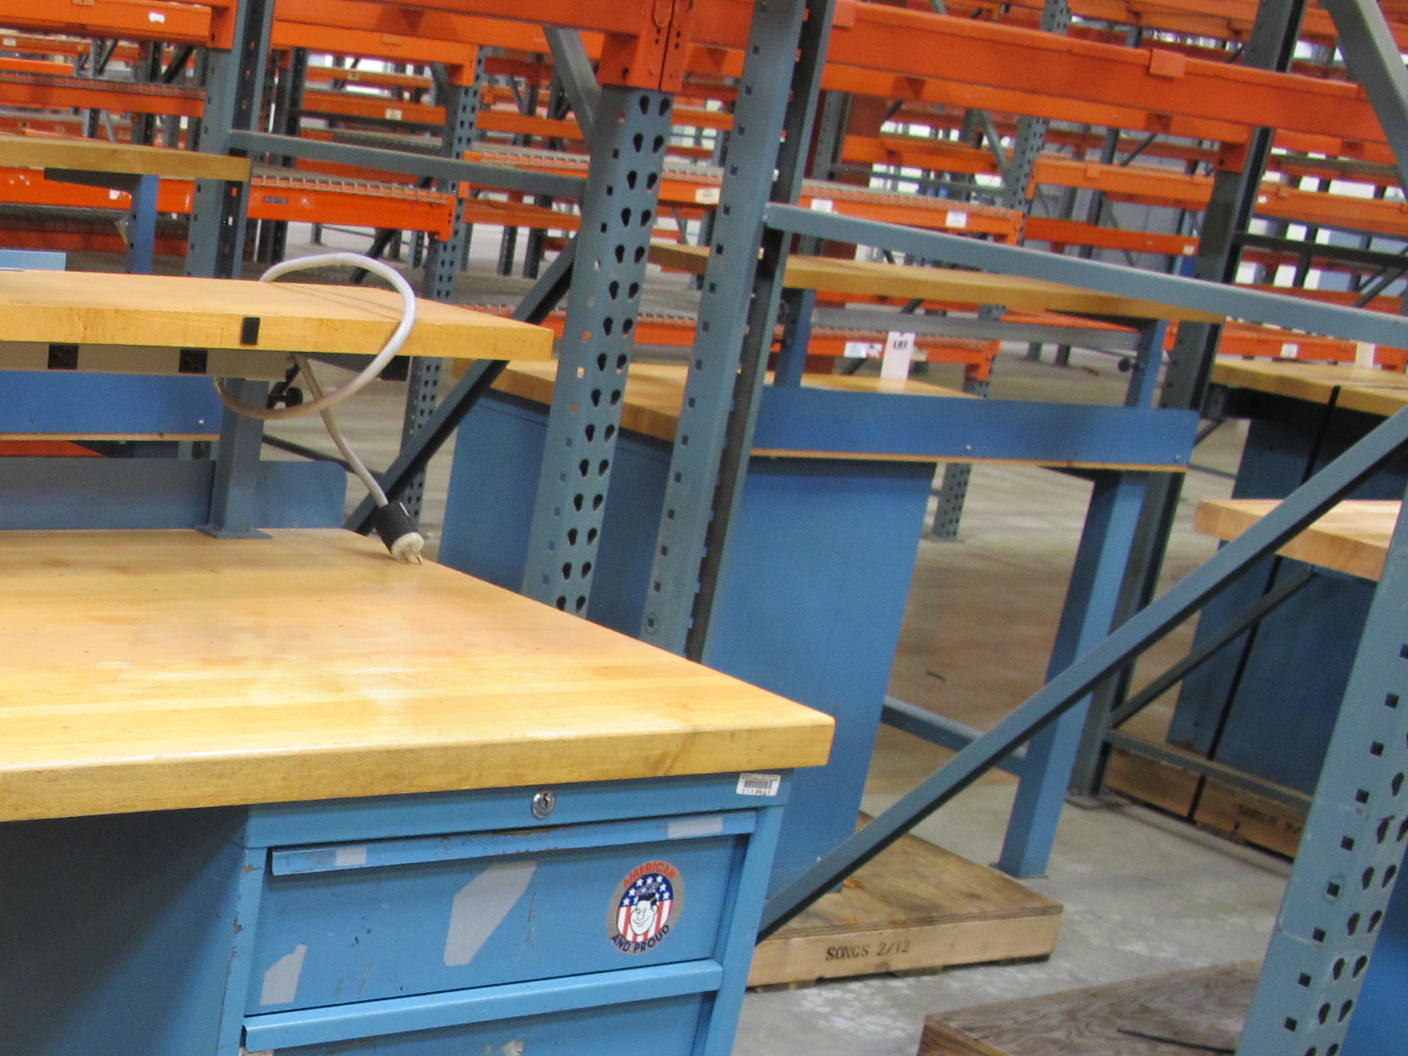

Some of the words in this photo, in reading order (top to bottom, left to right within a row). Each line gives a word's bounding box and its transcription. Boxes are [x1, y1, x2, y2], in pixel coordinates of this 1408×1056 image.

[623, 861, 677, 889] AMERICAN
[612, 934, 631, 952] AND
[632, 924, 670, 954] PROUD
